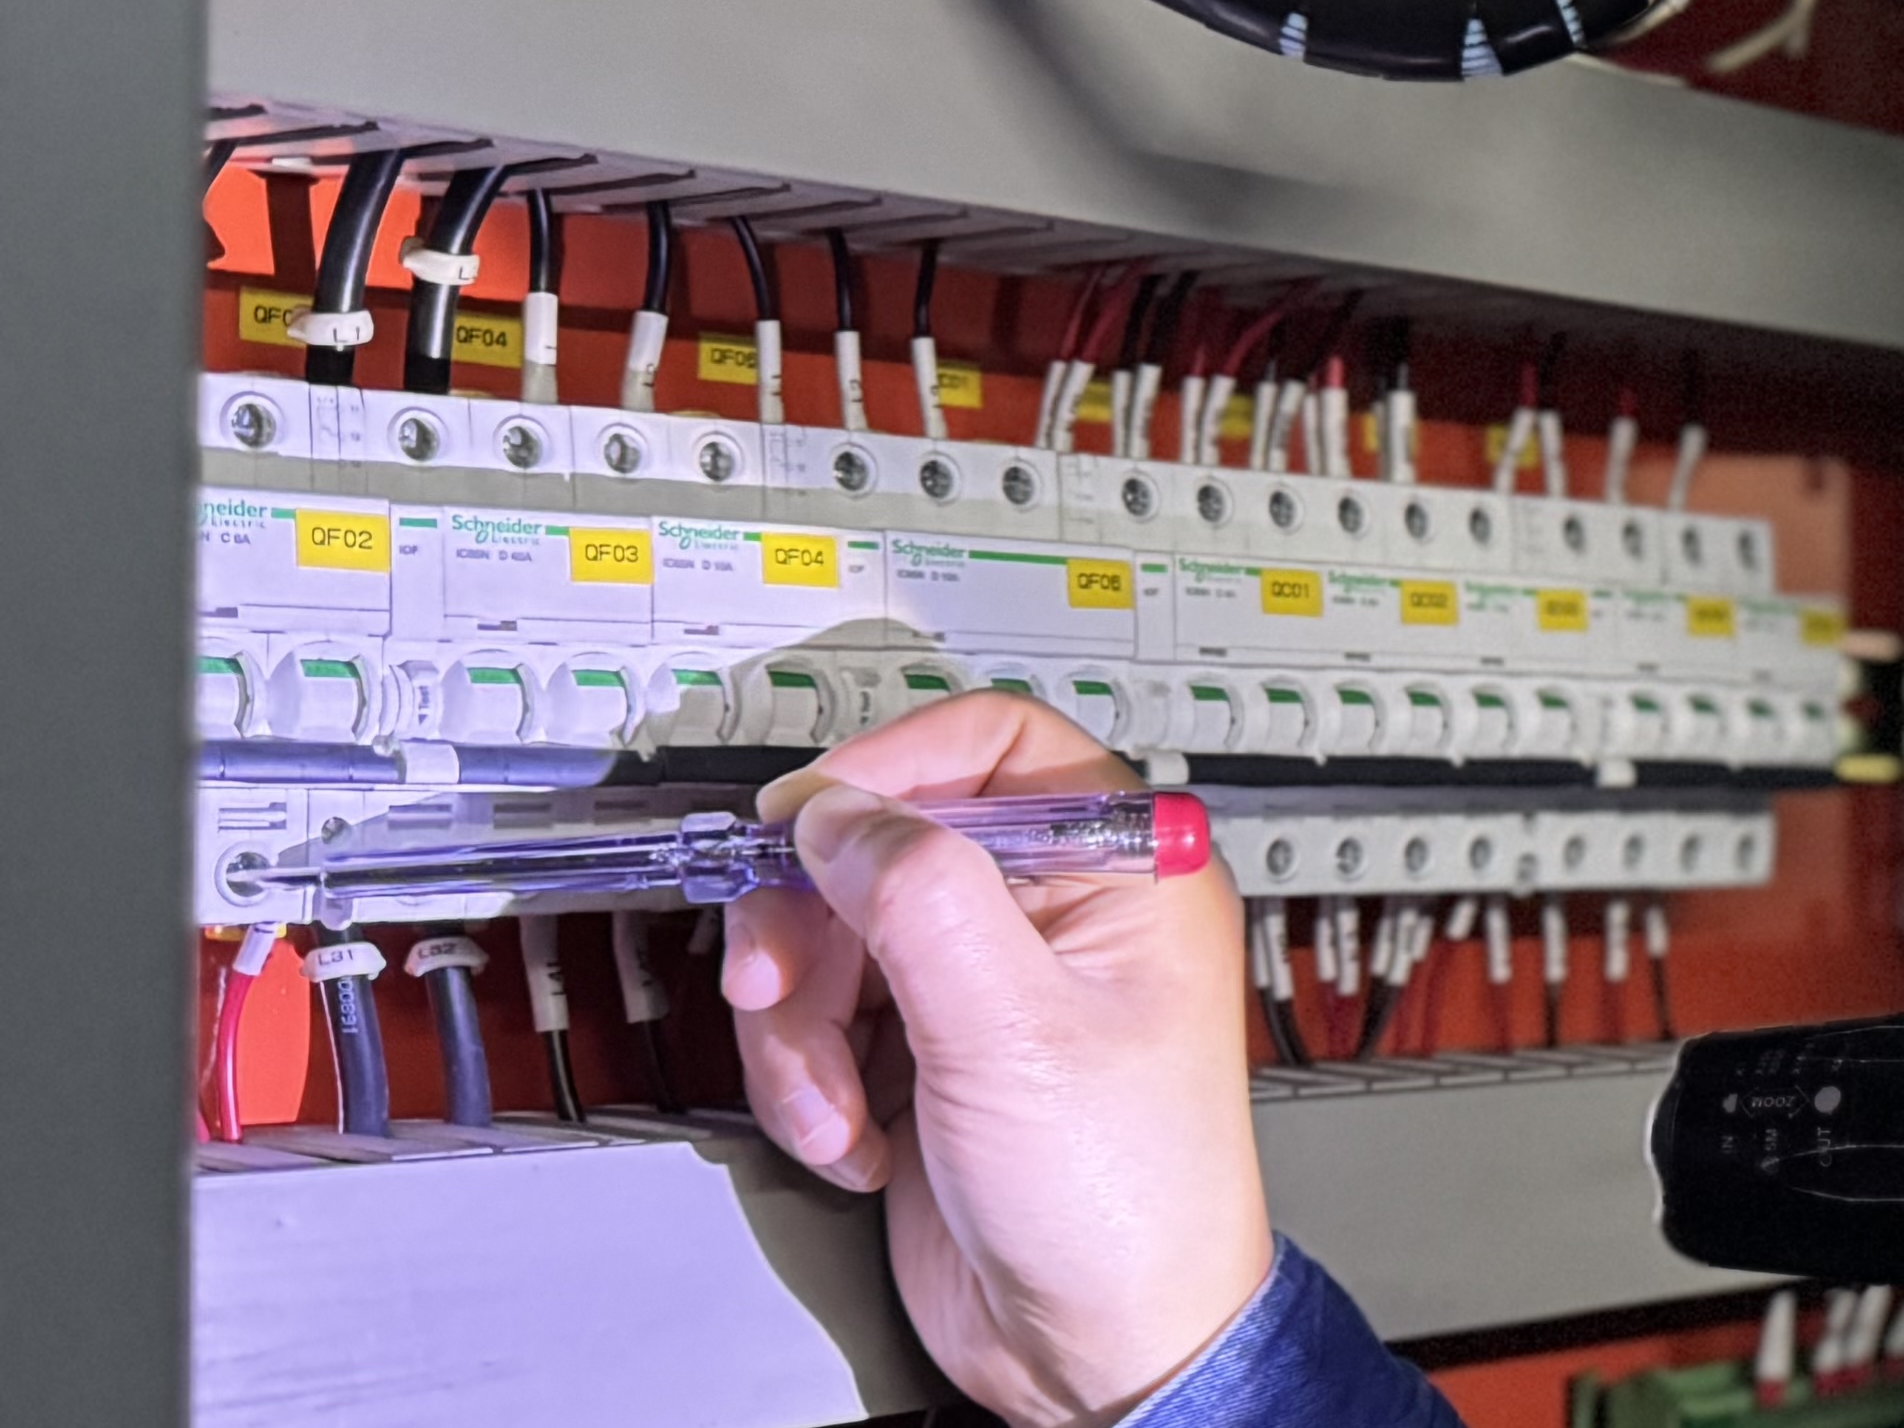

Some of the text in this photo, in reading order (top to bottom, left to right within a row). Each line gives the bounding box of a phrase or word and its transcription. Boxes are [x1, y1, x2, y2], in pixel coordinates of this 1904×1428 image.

[456, 326, 508, 348] QF04
[310, 526, 373, 550] QF02
[584, 543, 640, 563] QF03
[774, 547, 825, 568] QF04
